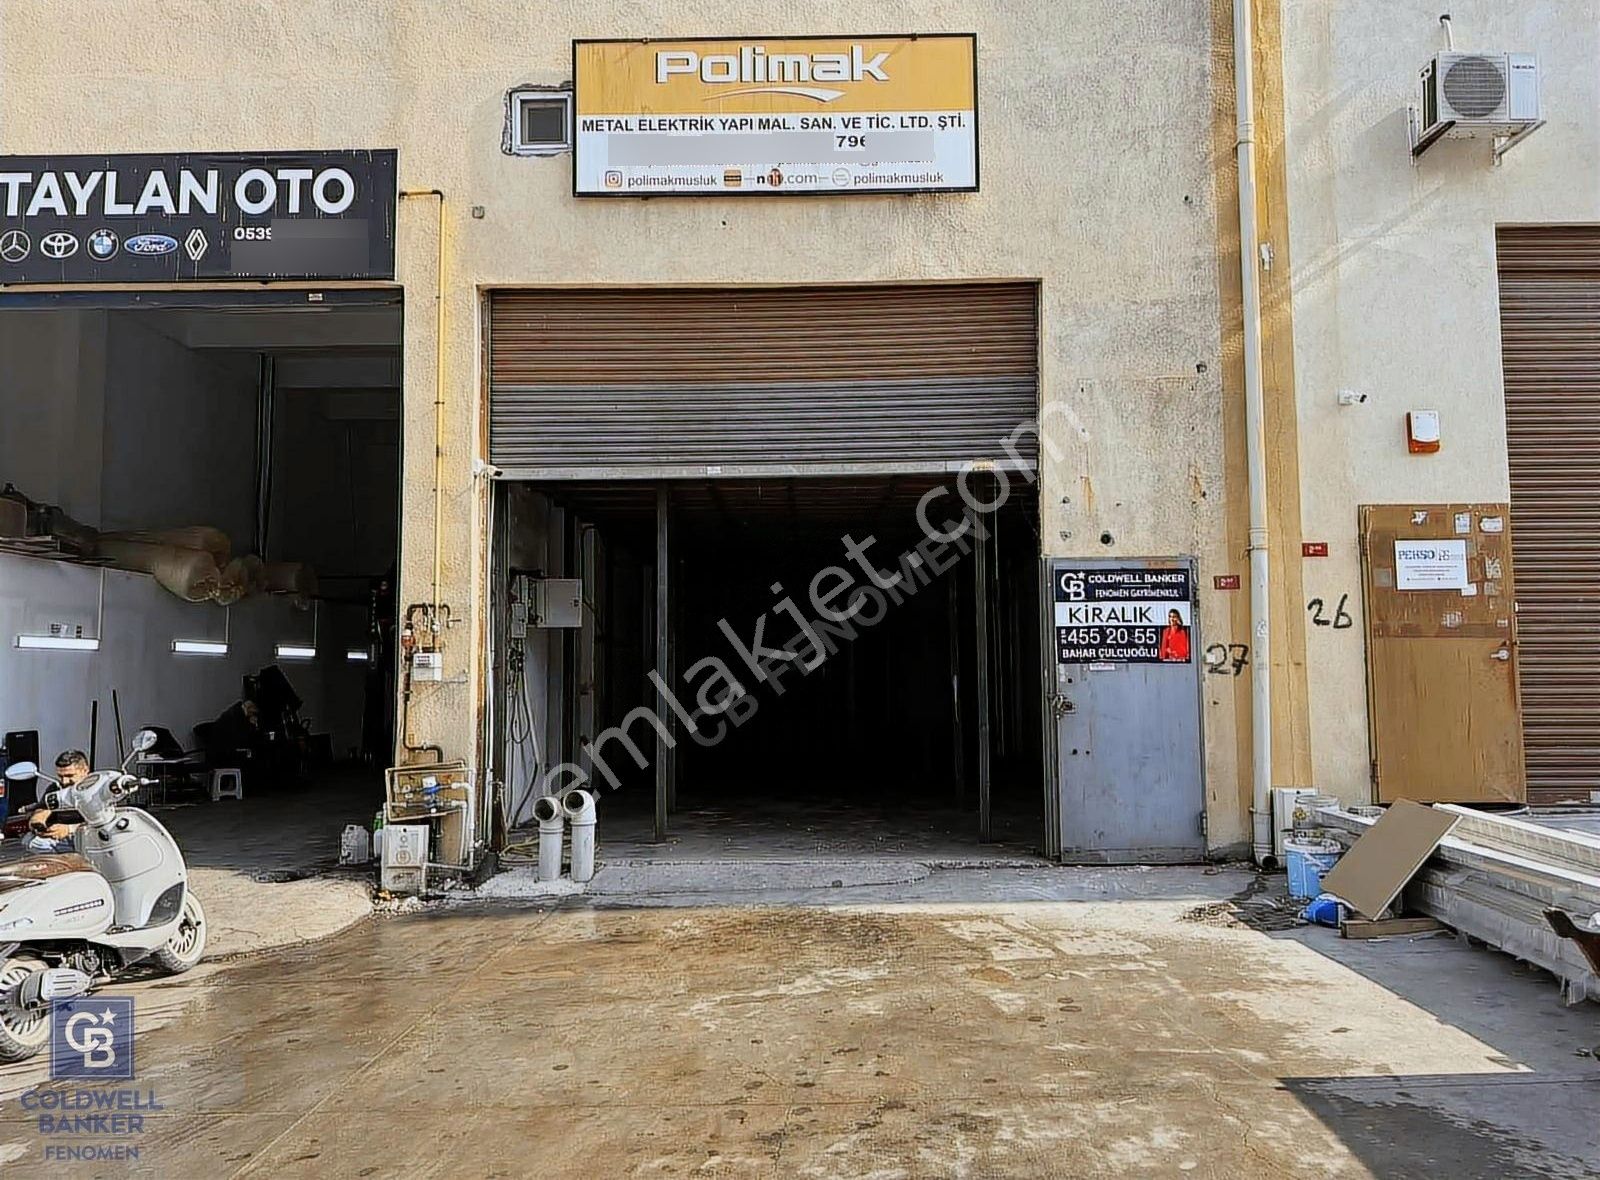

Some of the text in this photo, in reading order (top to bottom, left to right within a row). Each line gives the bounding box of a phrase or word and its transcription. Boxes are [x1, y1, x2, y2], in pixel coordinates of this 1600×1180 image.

[655, 44, 890, 84] Polimak
[582, 113, 966, 132] METAL ELEKTRİK YAPI MAL. SAN. VE TİC. LTD. ŞTİ.
[628, 174, 717, 188] polimakmusluk
[854, 171, 944, 186] polimakmusluk
[0, 167, 355, 216] TAYLAN OTO
[133, 239, 168, 252] Ford
[1088, 574, 1185, 583] COLDWELL BANKER
[1069, 604, 1152, 623] KİRALIK
[1308, 593, 1353, 629] 26
[1067, 628, 1100, 644] 455
[1106, 627, 1129, 644] 20
[1134, 628, 1157, 644] 55
[1062, 648, 1096, 658] BAHAR
[1205, 643, 1250, 676] 27
